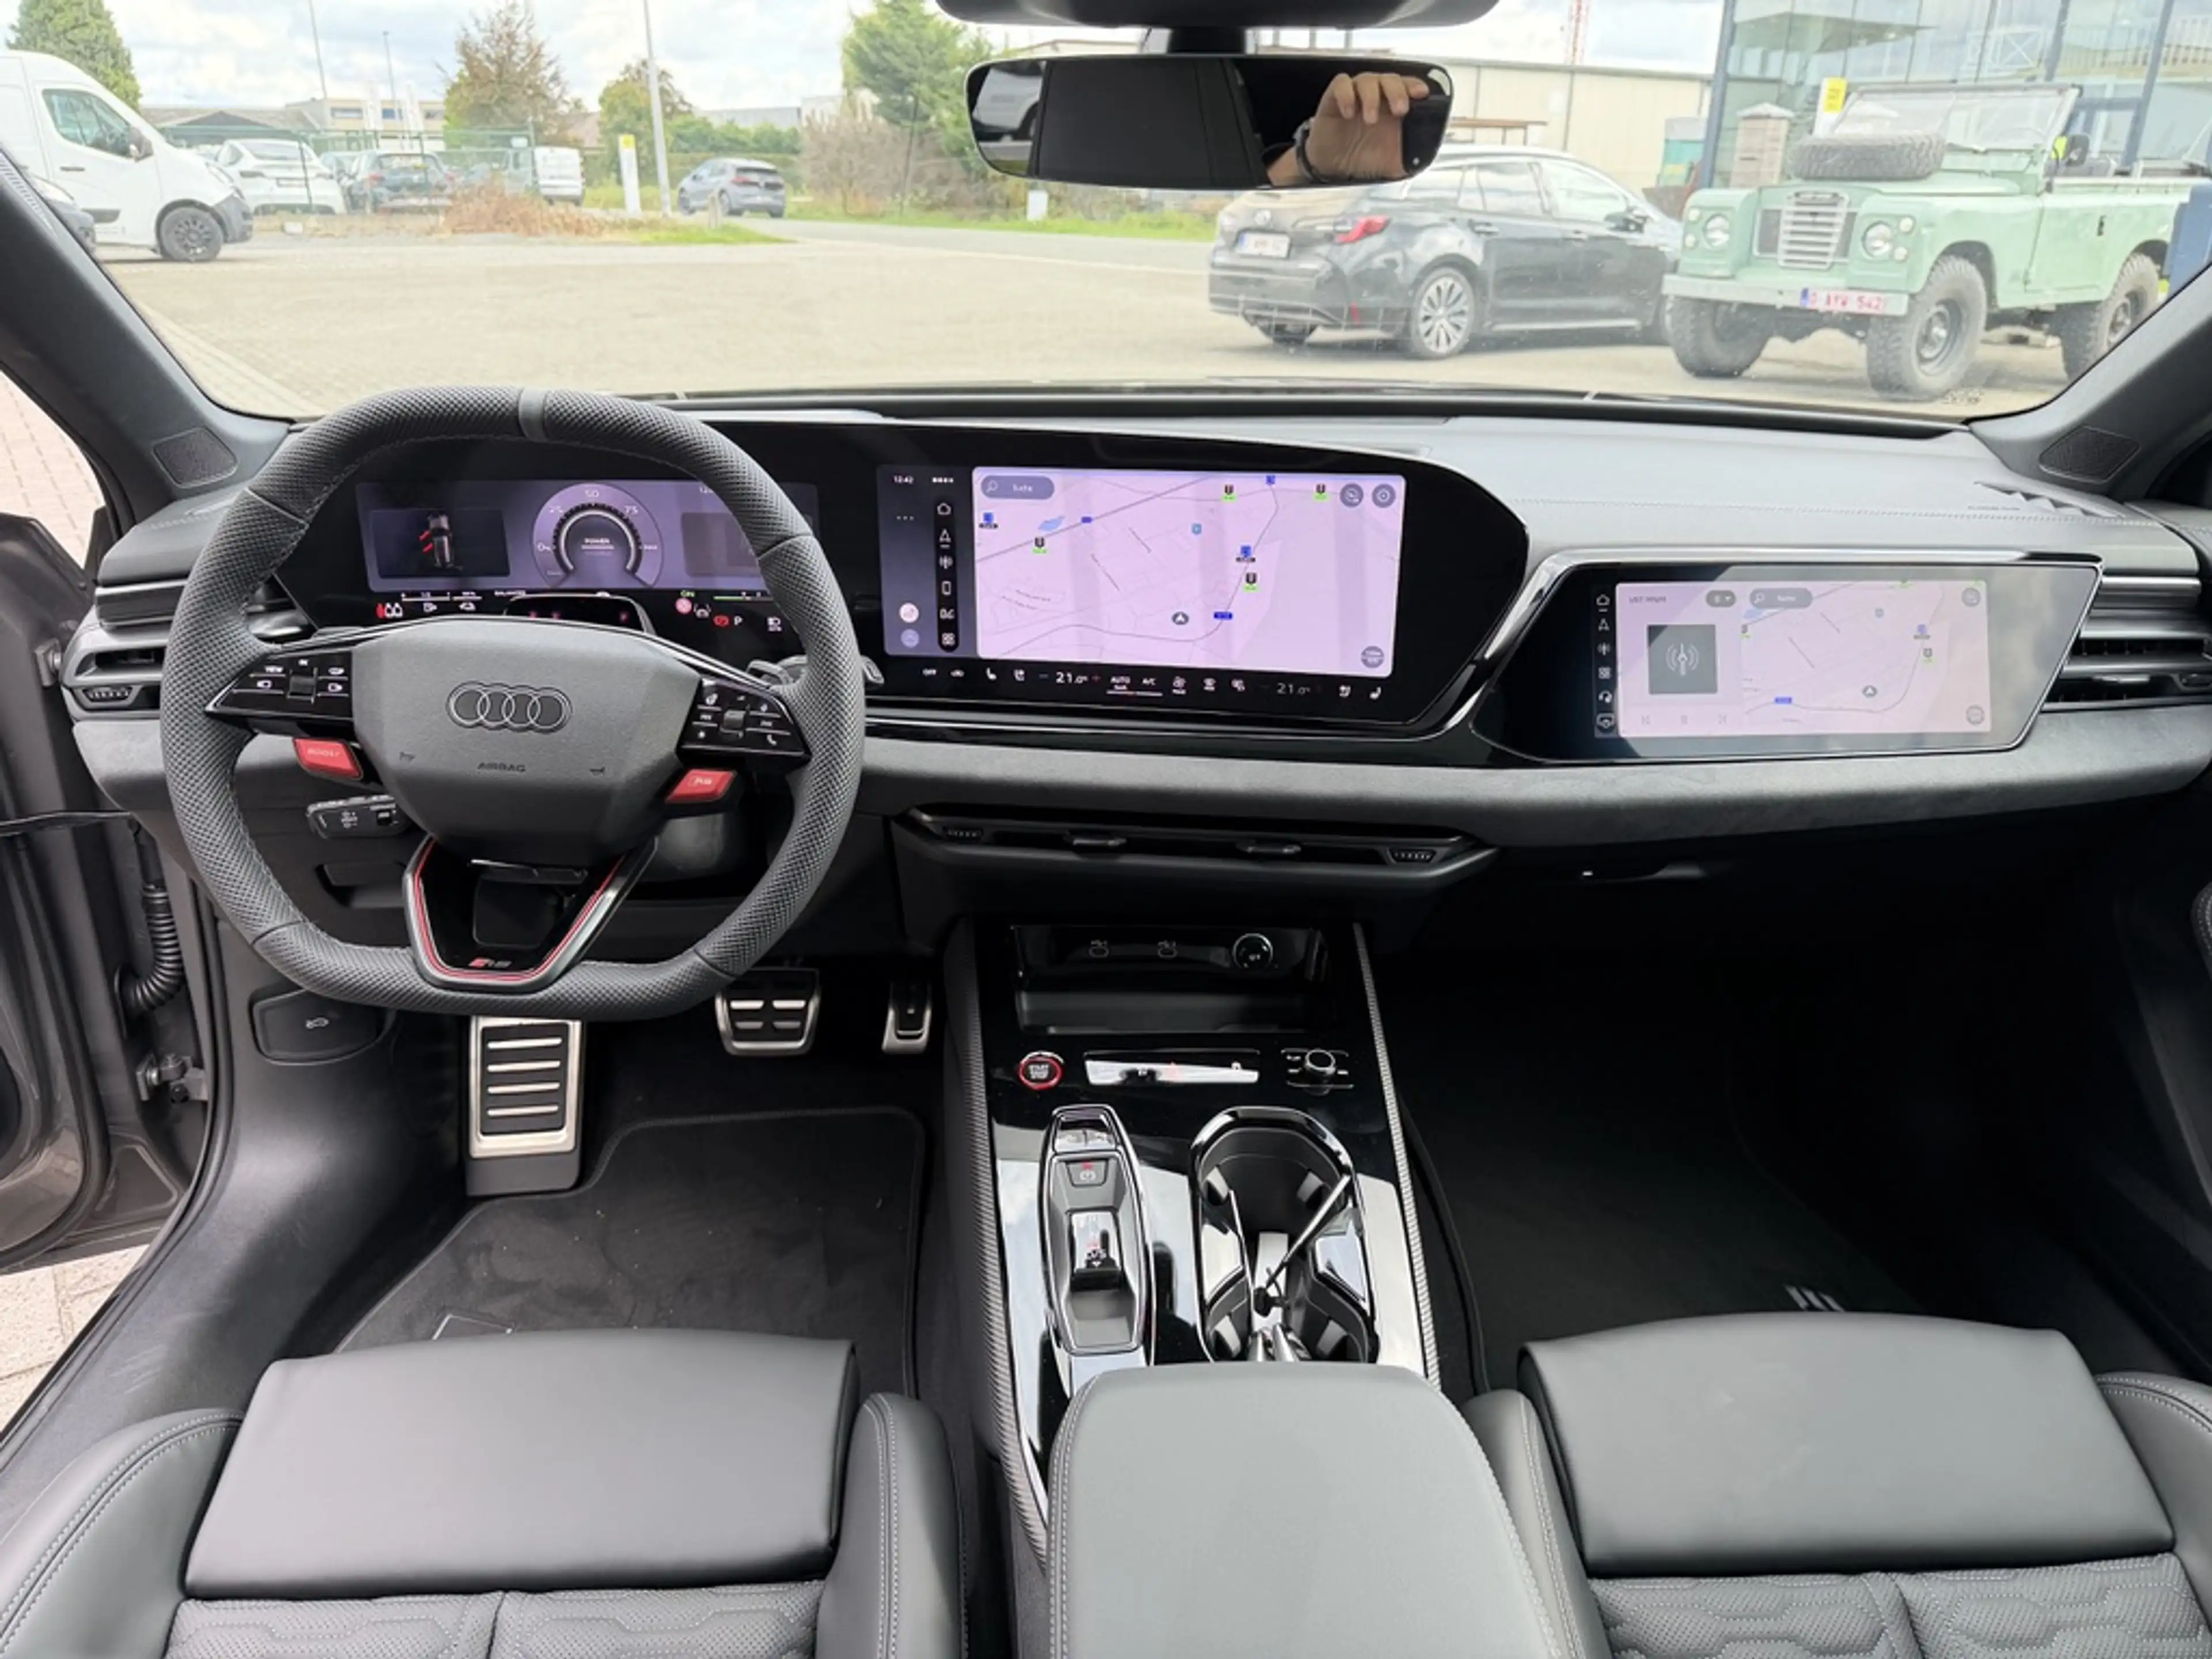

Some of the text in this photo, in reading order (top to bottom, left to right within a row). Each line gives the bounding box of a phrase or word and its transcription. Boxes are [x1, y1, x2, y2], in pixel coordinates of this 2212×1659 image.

[585, 490, 600, 498] 50
[624, 506, 638, 514] 75
[476, 762, 527, 772] AIRBAG
